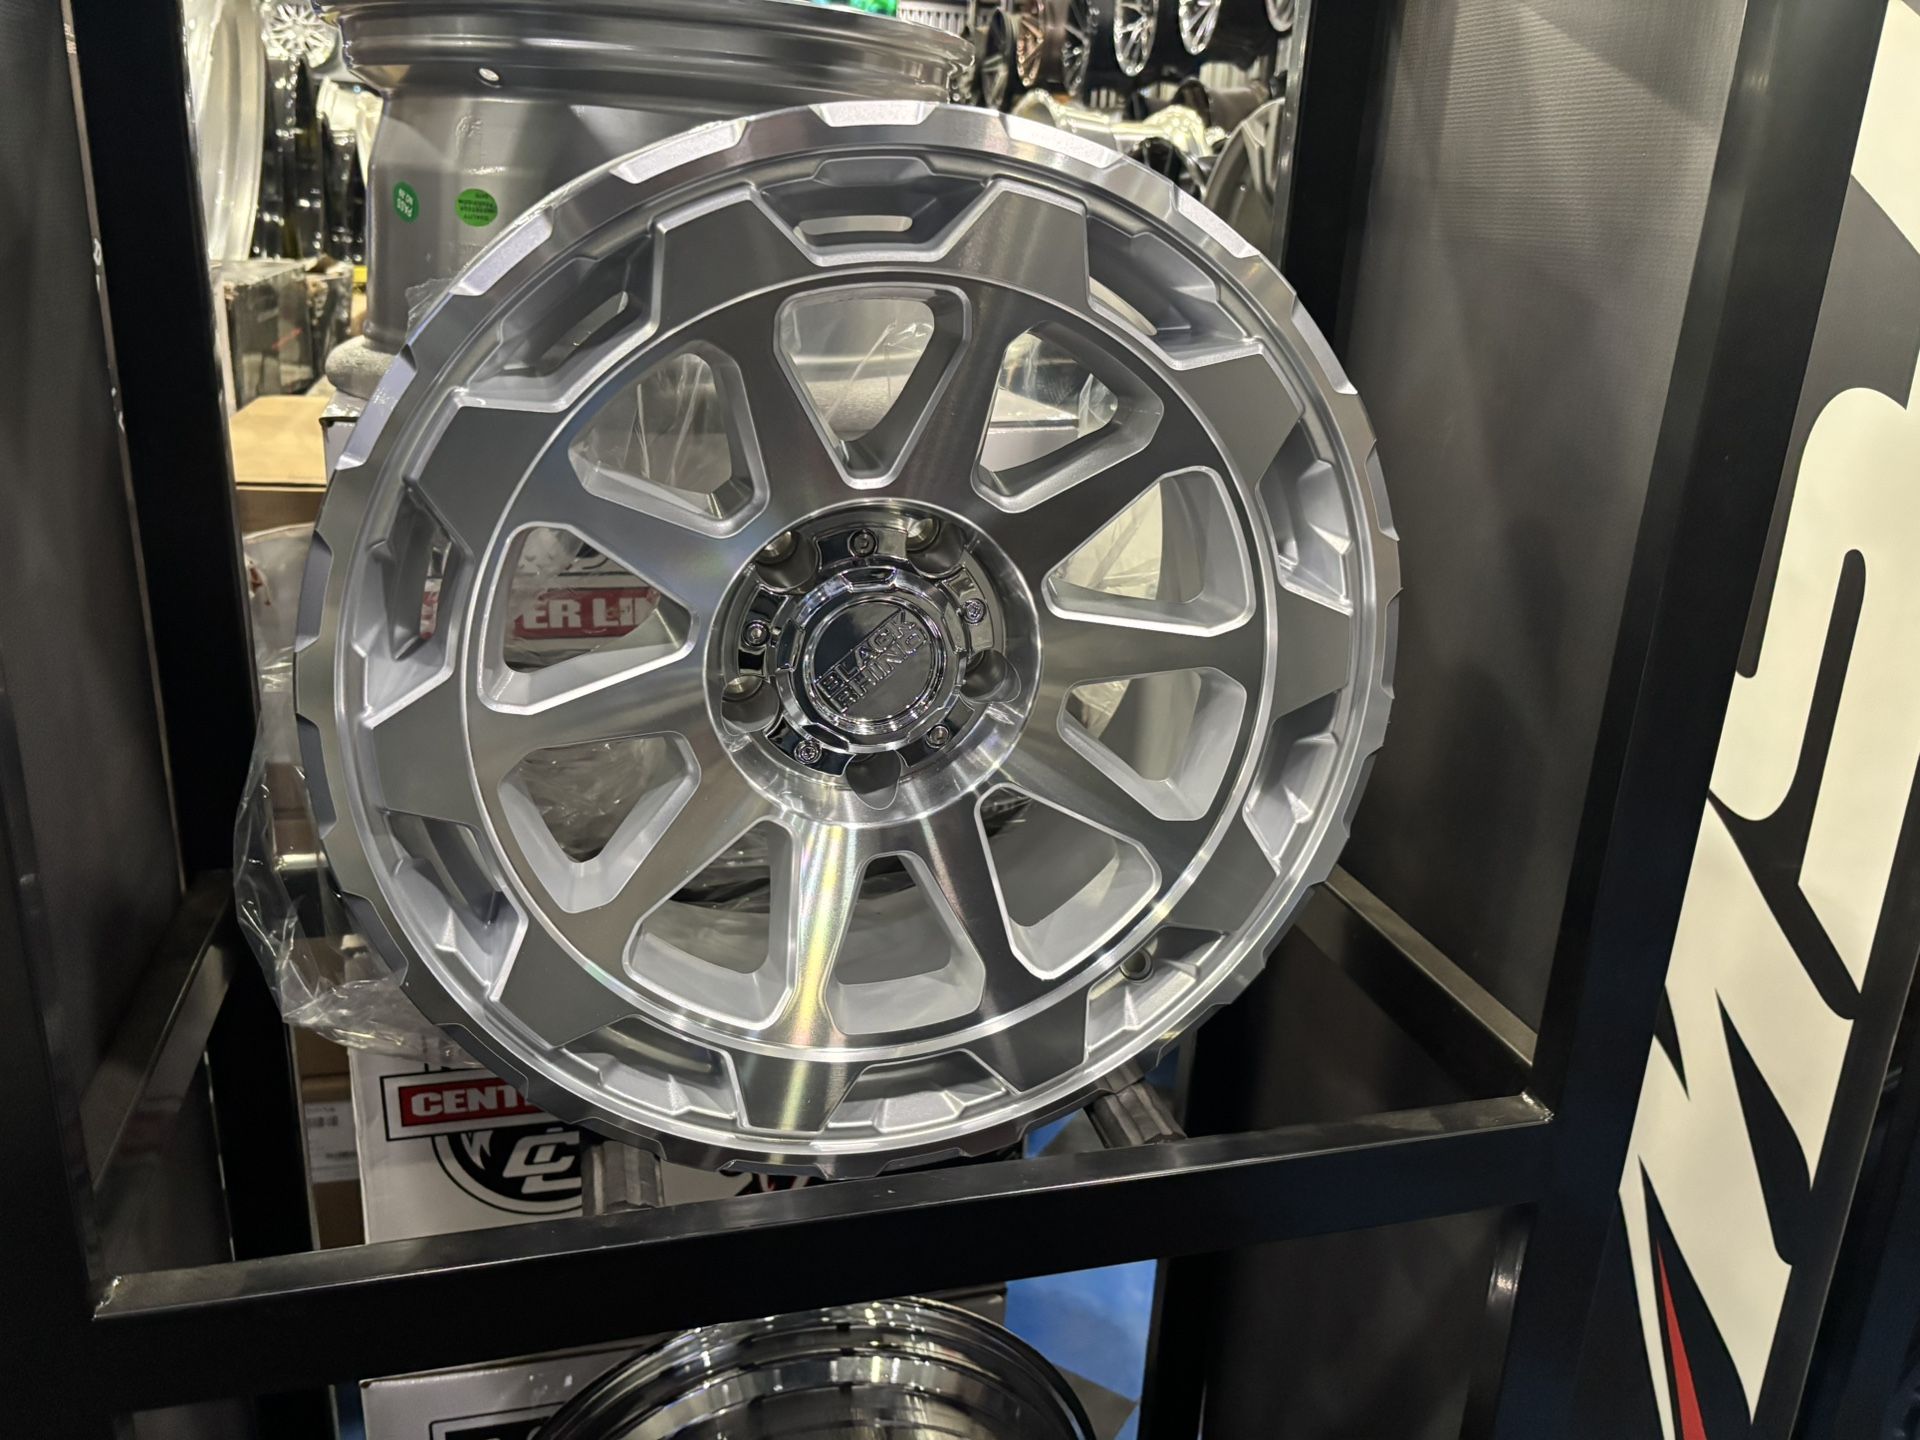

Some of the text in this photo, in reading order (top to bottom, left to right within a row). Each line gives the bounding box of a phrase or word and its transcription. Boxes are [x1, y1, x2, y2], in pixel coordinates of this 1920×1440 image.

[815, 608, 915, 698] BLACK
[829, 628, 929, 717] RHINO
[411, 1084, 530, 1117] CENT
